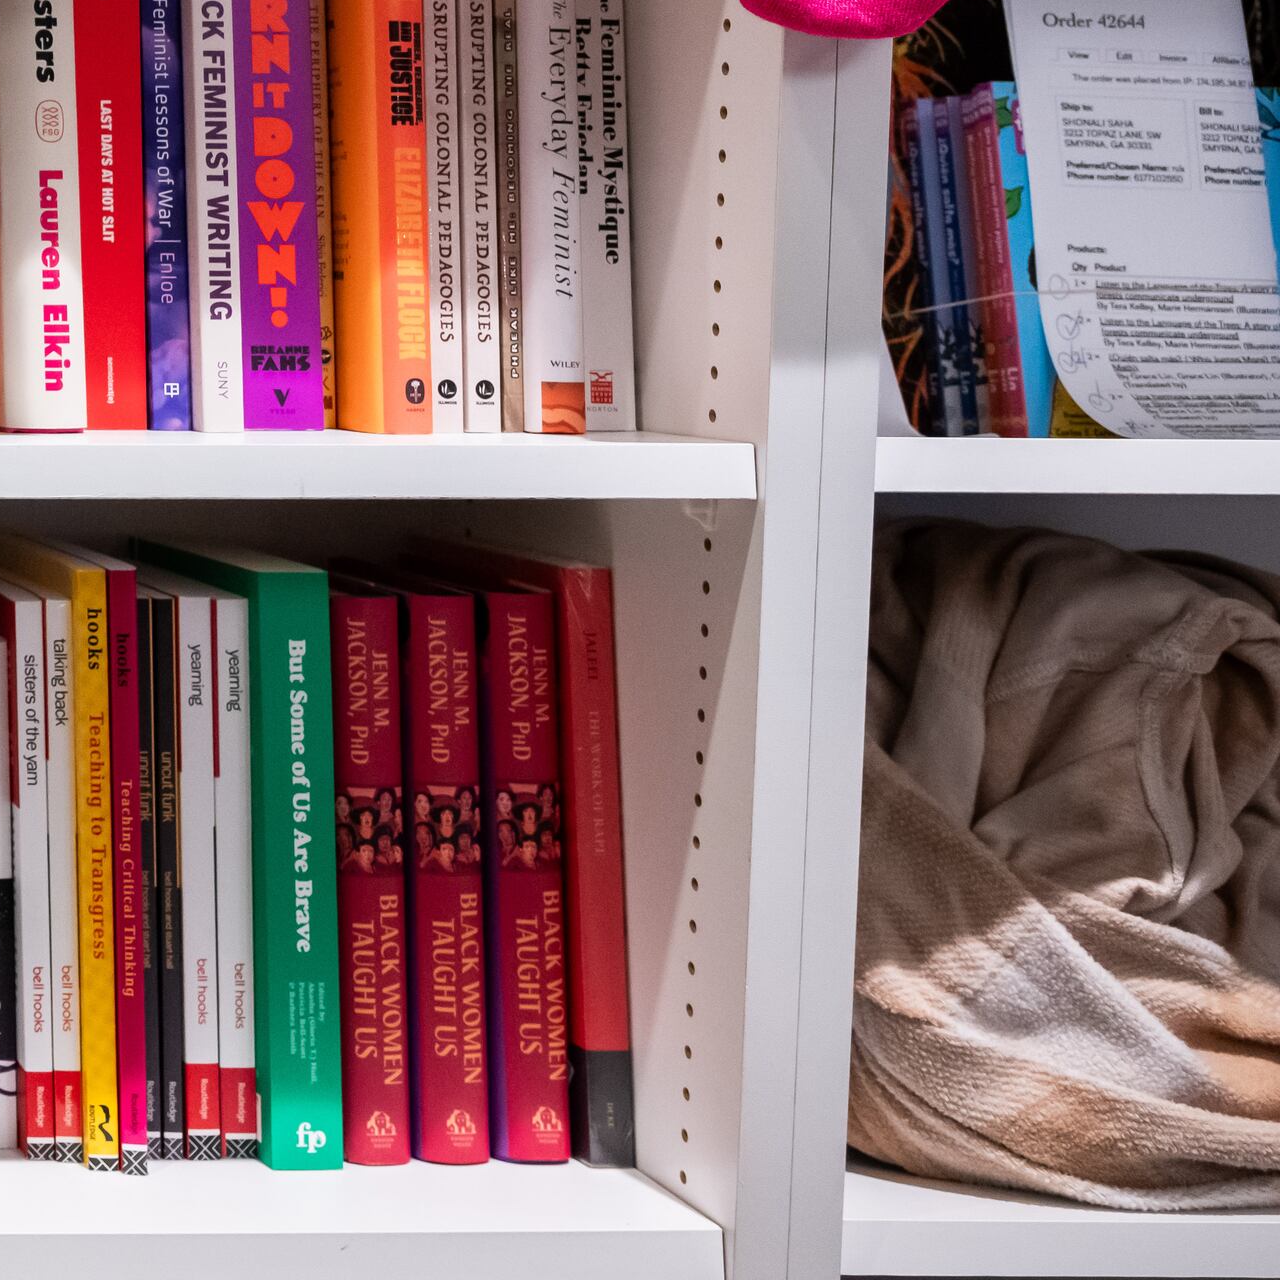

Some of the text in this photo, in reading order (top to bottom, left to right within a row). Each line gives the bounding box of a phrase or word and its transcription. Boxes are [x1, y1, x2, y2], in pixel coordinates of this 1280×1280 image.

[600, 17, 621, 142] Feminine
[1042, 12, 1146, 29] Order 42644
[203, 50, 229, 187] FEMINIST
[206, 196, 232, 321] WRITING
[598, 146, 623, 265] Mystique
[38, 169, 70, 392] Lauren Elkin
[287, 639, 314, 953] But Some of Us Are Brave
[431, 917, 457, 1057] TAUGHT US
[459, 892, 481, 1084] BLACK WOMEN
